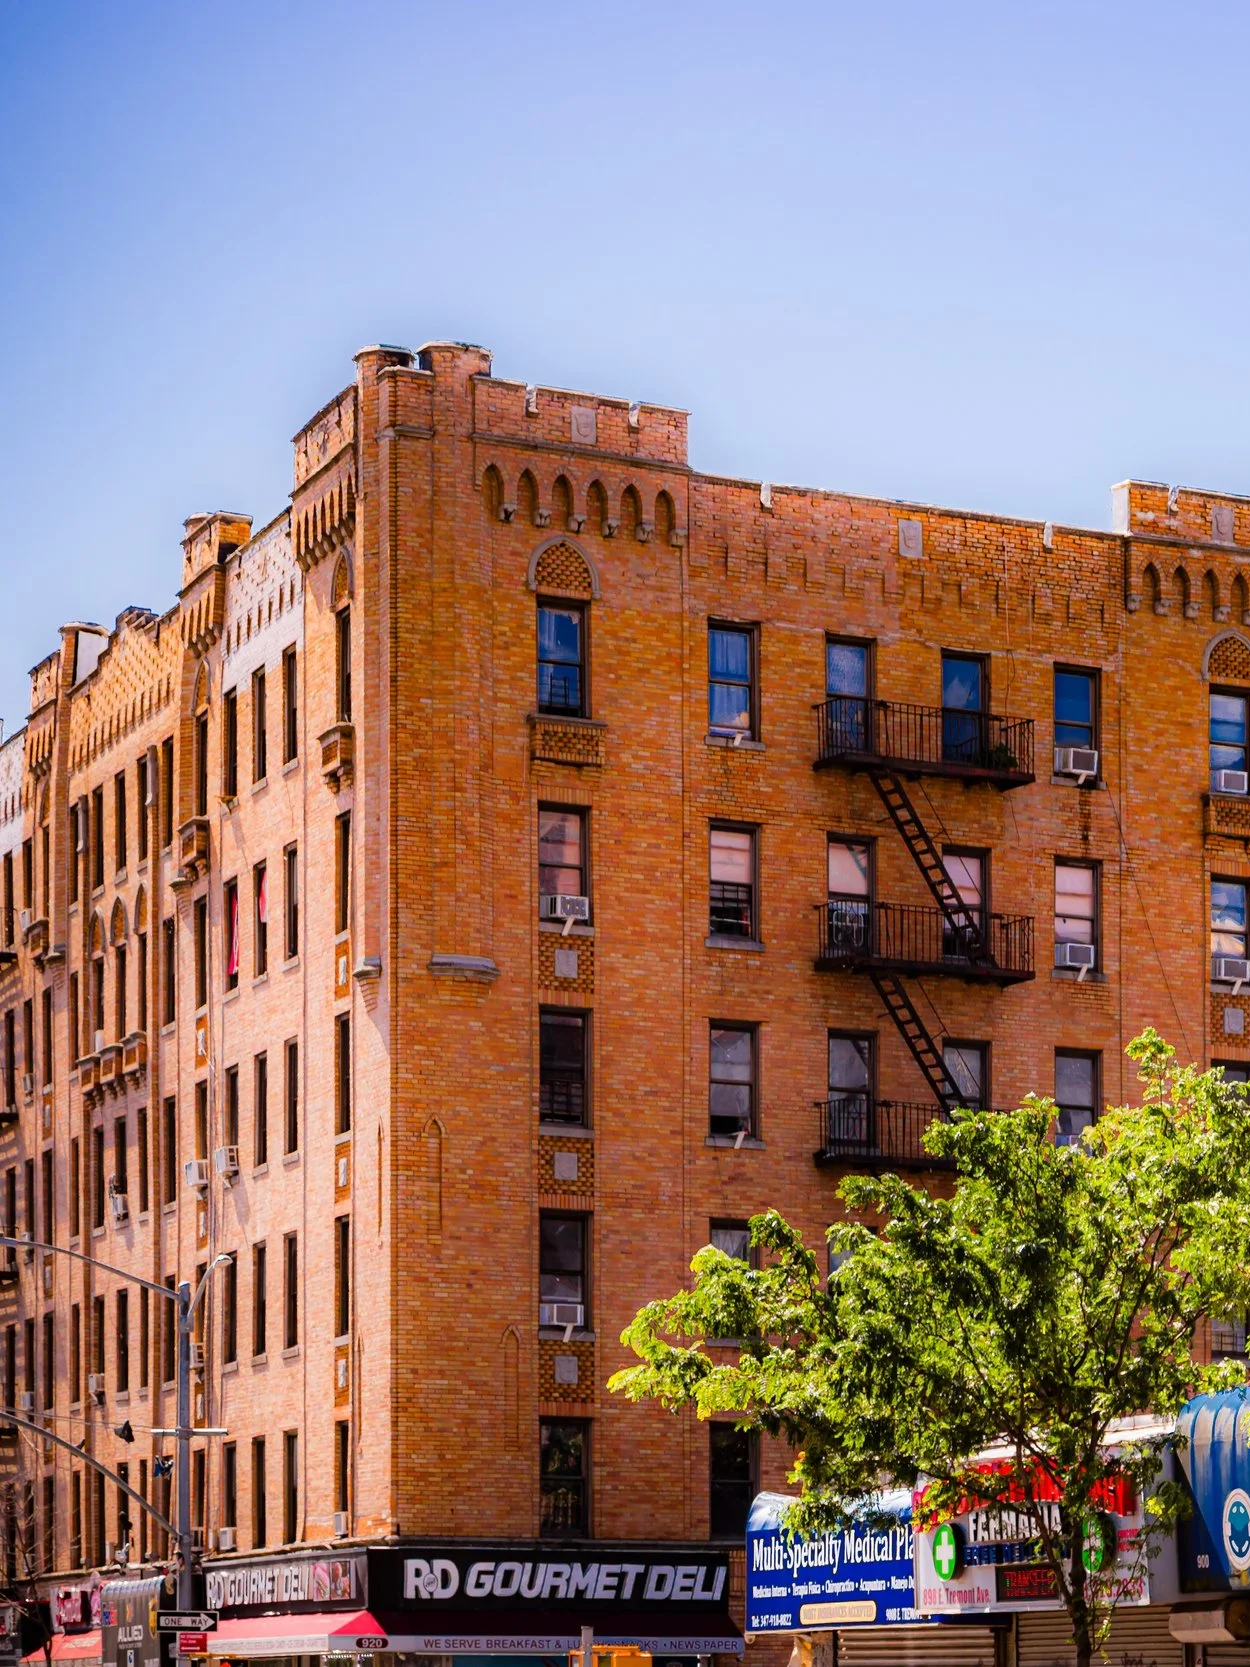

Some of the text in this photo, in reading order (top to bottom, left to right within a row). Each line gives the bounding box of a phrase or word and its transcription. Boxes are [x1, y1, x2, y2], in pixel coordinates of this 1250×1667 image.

[753, 1534, 842, 1578] Multi-Specialty
[844, 1526, 892, 1564] Medical
[227, 1566, 280, 1606] GOURMET
[283, 1562, 309, 1601] DELI
[464, 1561, 645, 1599] GOURMET
[643, 1565, 727, 1601] DELI
[945, 1587, 975, 1604] Tremont
[164, 1618, 209, 1627] ONE WAY
[117, 1625, 144, 1643] ALLIED
[361, 1638, 382, 1648] 920
[423, 1639, 441, 1649] WE
[445, 1639, 481, 1649] SERVE
[486, 1639, 555, 1649] BREAKFAST
[554, 1639, 562, 1649] &
[670, 1640, 701, 1650] NEWS
[704, 1640, 738, 1650] PAPER
